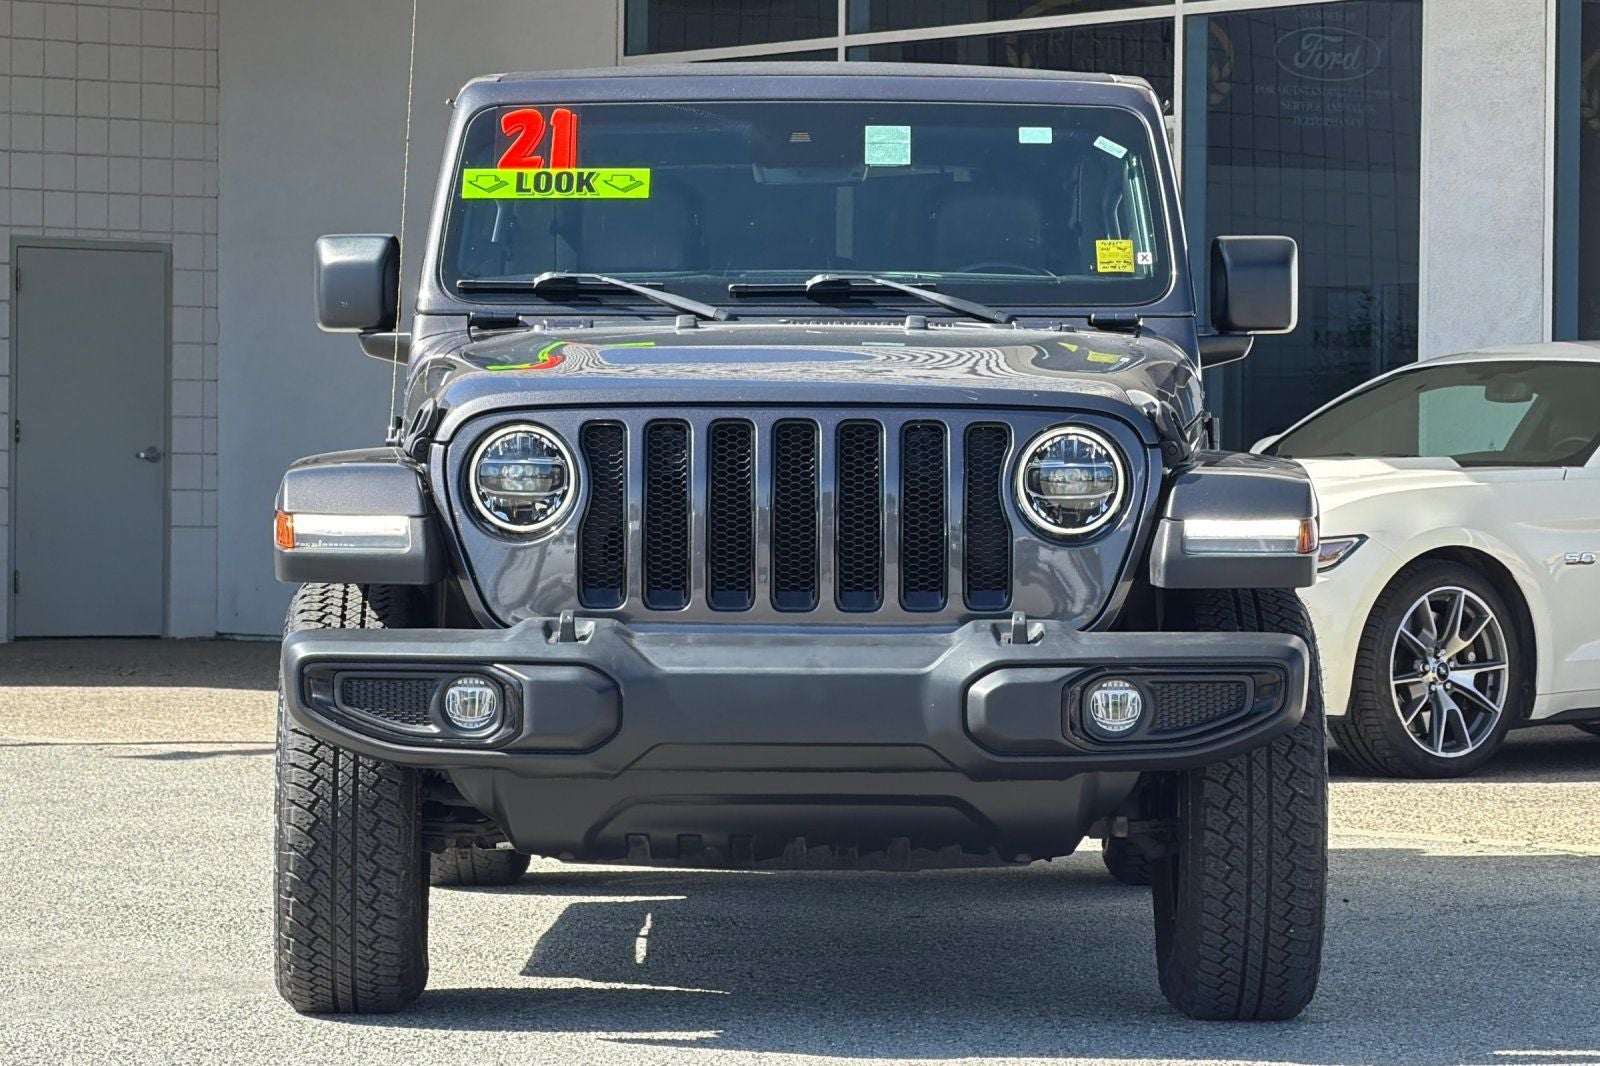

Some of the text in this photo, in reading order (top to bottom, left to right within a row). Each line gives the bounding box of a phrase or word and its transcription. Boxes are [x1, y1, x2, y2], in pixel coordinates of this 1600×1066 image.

[1294, 33, 1362, 70] Ford
[497, 108, 577, 169] 21
[515, 171, 599, 196] LOOK
